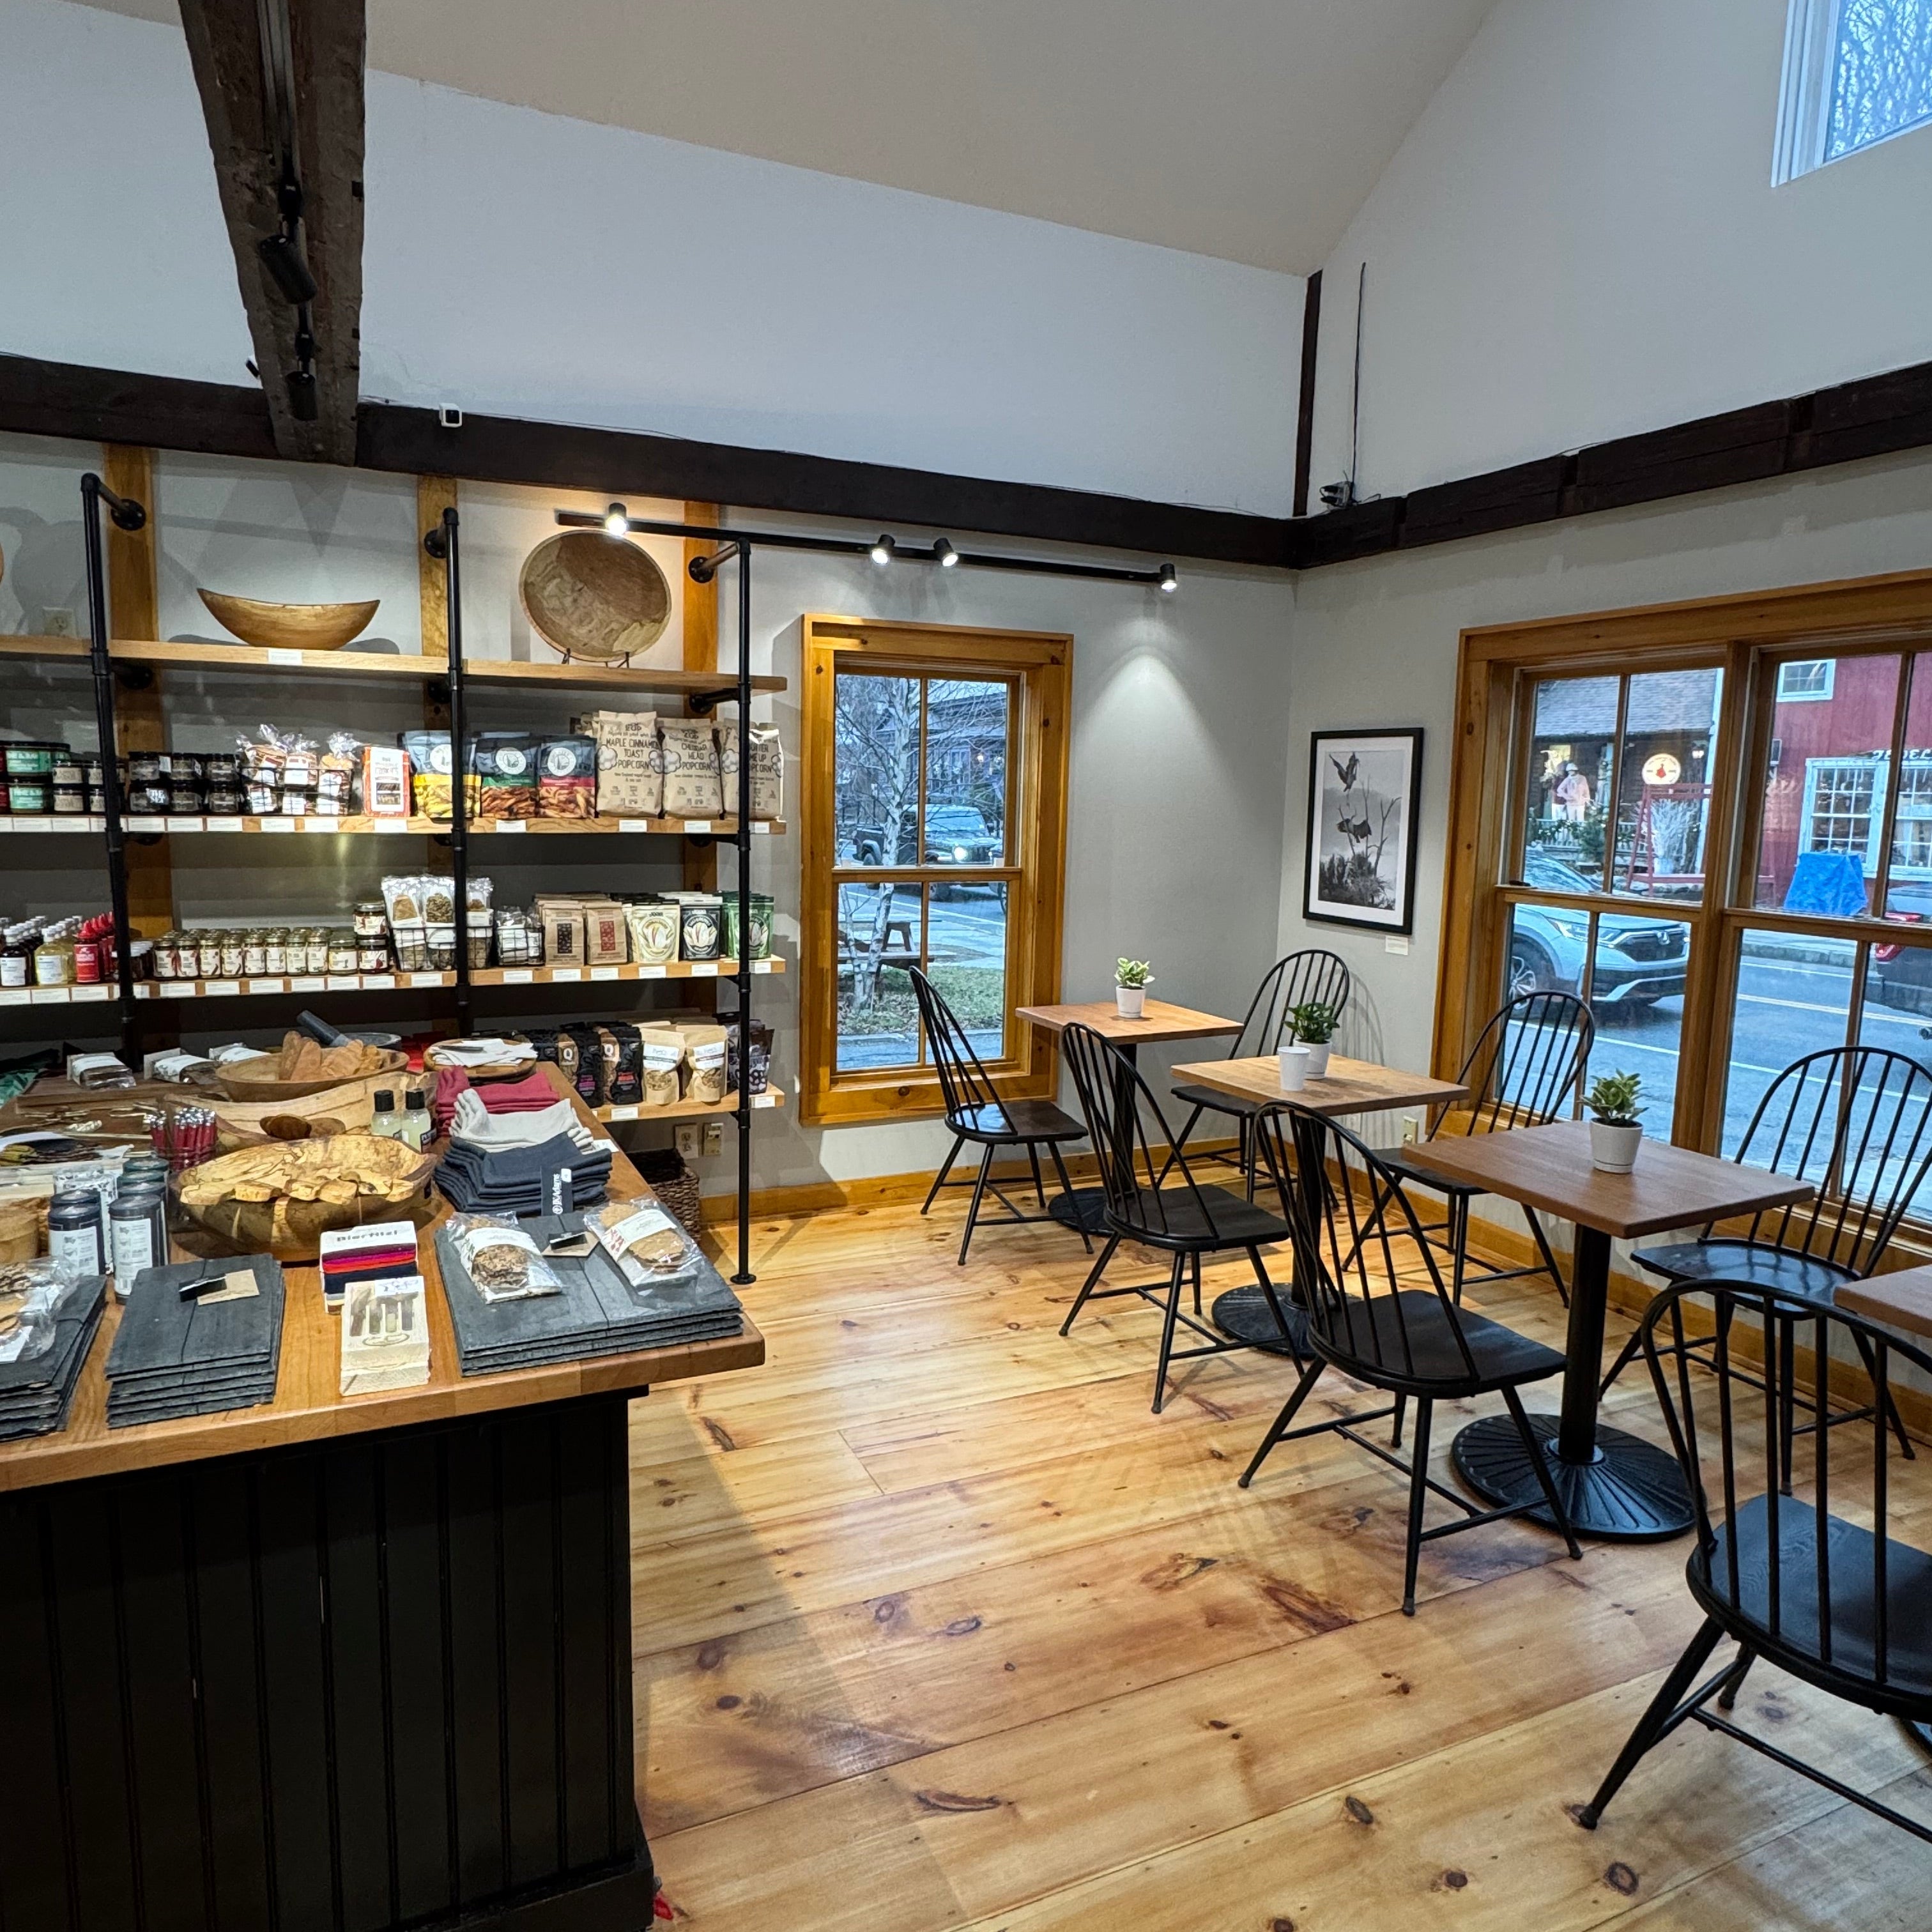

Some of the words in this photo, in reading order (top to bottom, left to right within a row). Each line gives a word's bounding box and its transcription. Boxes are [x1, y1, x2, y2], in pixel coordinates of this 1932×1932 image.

[606, 738, 627, 747] MAPLE
[624, 748, 643, 758] TOAST
[750, 744, 769, 753] UTTER
[688, 751, 704, 760] HEAD
[1871, 749, 1932, 761] JEEL
[618, 759, 650, 770] POPCORN
[682, 761, 711, 771] POPCORN
[751, 763, 772, 773] PCORN
